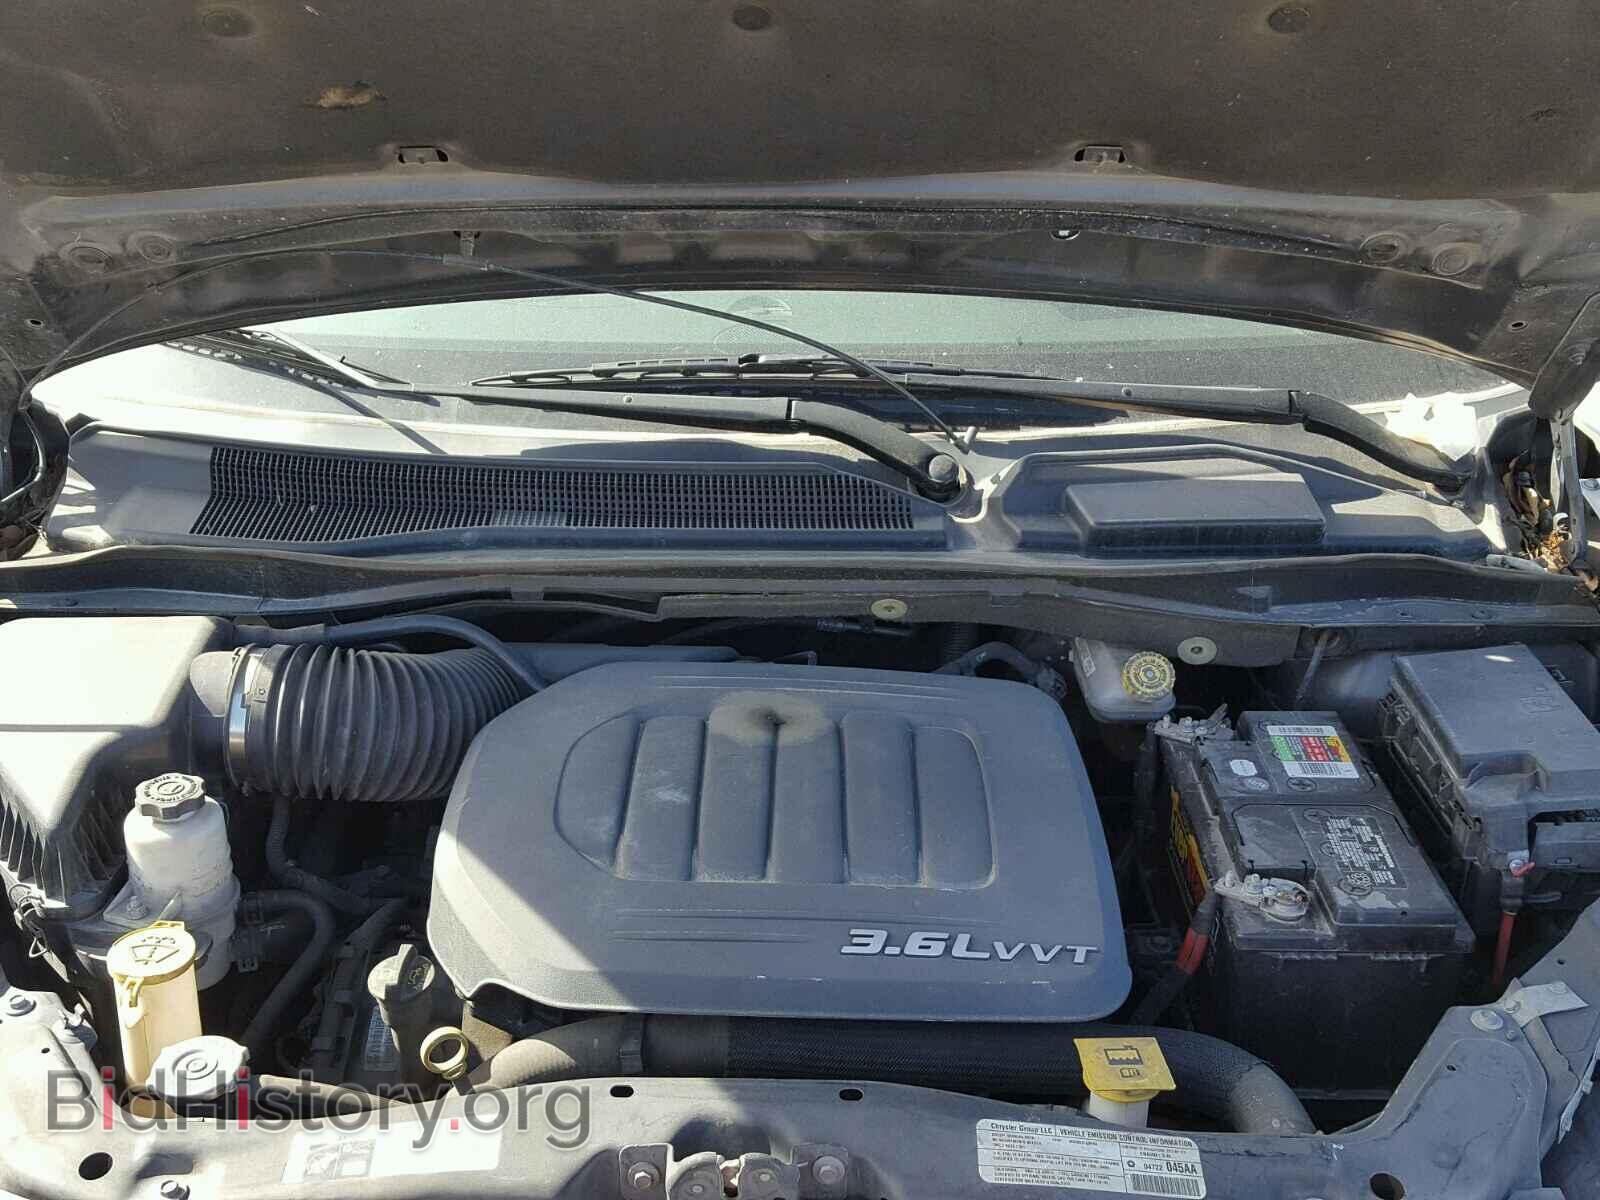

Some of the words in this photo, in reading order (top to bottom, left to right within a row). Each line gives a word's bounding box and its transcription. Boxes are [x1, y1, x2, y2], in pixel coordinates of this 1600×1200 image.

[840, 928, 991, 960] 3.6L
[992, 941, 1098, 964] VVT
[991, 1122, 1017, 1132] Chrysler
[1019, 1124, 1039, 1134] Group
[1040, 1126, 1053, 1135] LLC
[1060, 1128, 1086, 1138] VEHICLE
[1087, 1130, 1118, 1141] EMISSION
[1119, 1134, 1149, 1144] CONTROL
[1149, 1136, 1193, 1148] INFORMATION
